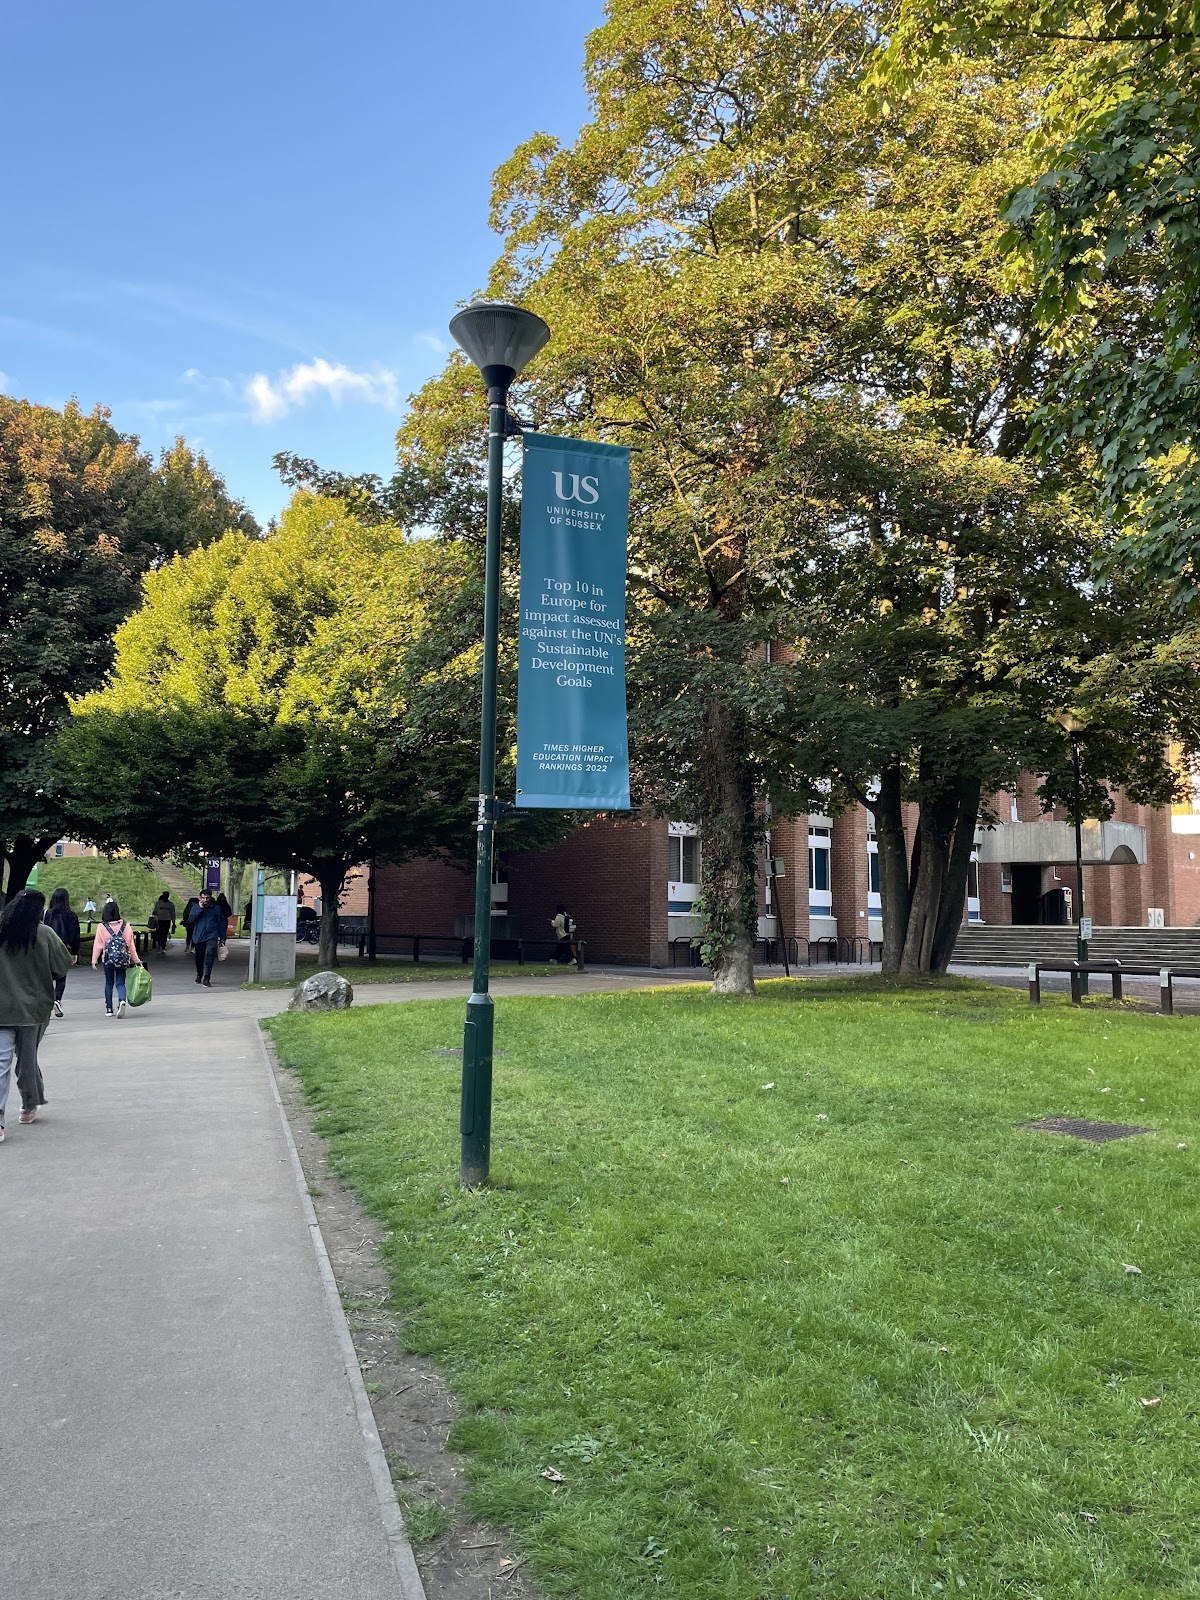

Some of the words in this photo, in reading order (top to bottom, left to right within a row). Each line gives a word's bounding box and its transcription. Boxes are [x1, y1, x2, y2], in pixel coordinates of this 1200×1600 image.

[546, 506, 606, 521] UNIVERSITY
[549, 516, 562, 525] OF
[565, 518, 602, 531] SUSSEX
[543, 578, 572, 594] Top
[575, 581, 589, 593] 10
[591, 584, 604, 596] in
[540, 593, 587, 611] Europe
[590, 600, 607, 613] for
[524, 608, 570, 625] impact
[573, 614, 621, 630] assessed
[522, 626, 567, 640] against
[571, 628, 591, 640] the
[594, 630, 622, 646] UN's
[537, 641, 609, 659] Sustainable
[531, 657, 615, 676] Development
[556, 675, 593, 688] Goals
[543, 743, 570, 752] TIMES
[572, 745, 605, 753] HIGHER
[532, 753, 581, 762] EDUCATION
[583, 755, 614, 763] IMPACT
[539, 762, 583, 771] RANKINGS
[585, 764, 608, 772] 2022
